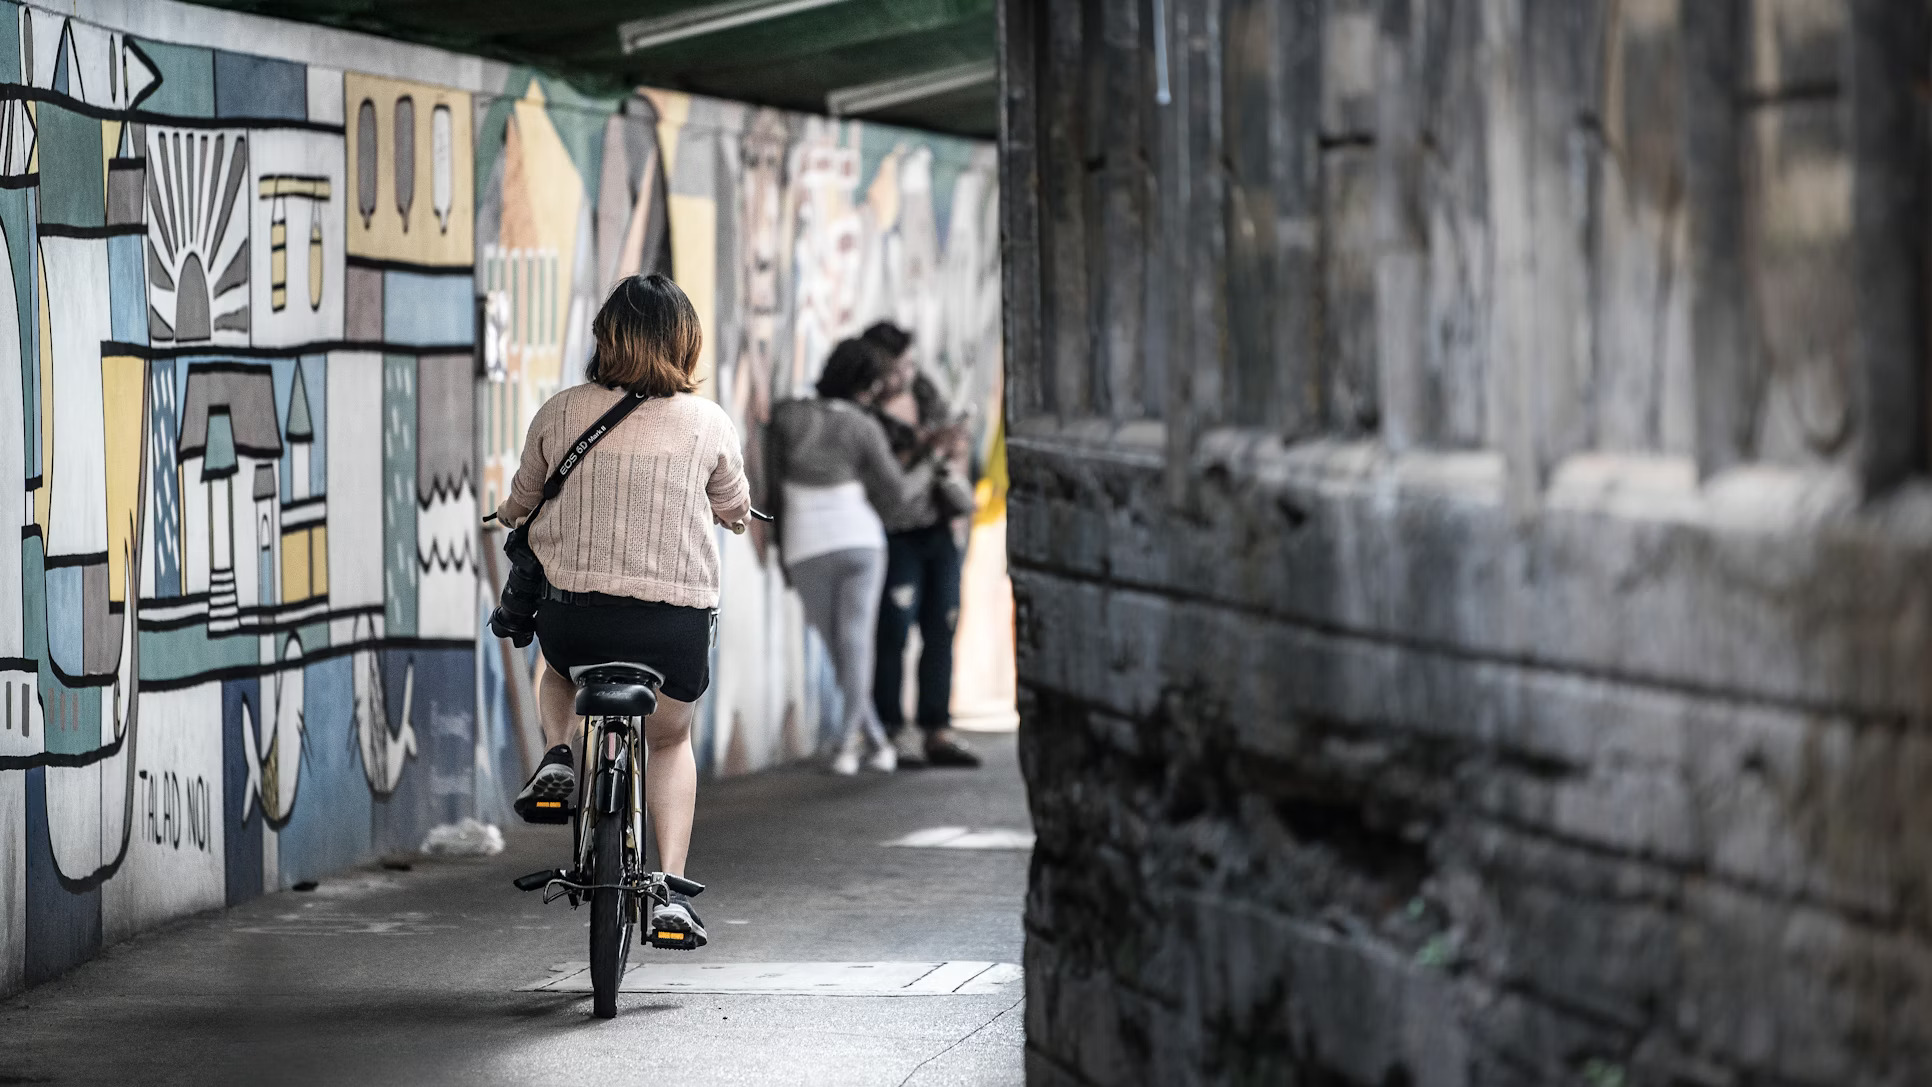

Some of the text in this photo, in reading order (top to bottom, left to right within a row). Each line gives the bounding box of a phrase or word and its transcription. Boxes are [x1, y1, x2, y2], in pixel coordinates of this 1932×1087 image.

[560, 453, 578, 475] EOS
[576, 441, 588, 454] 6D
[588, 429, 603, 443] Mark
[138, 769, 211, 854] TALAD NOI
